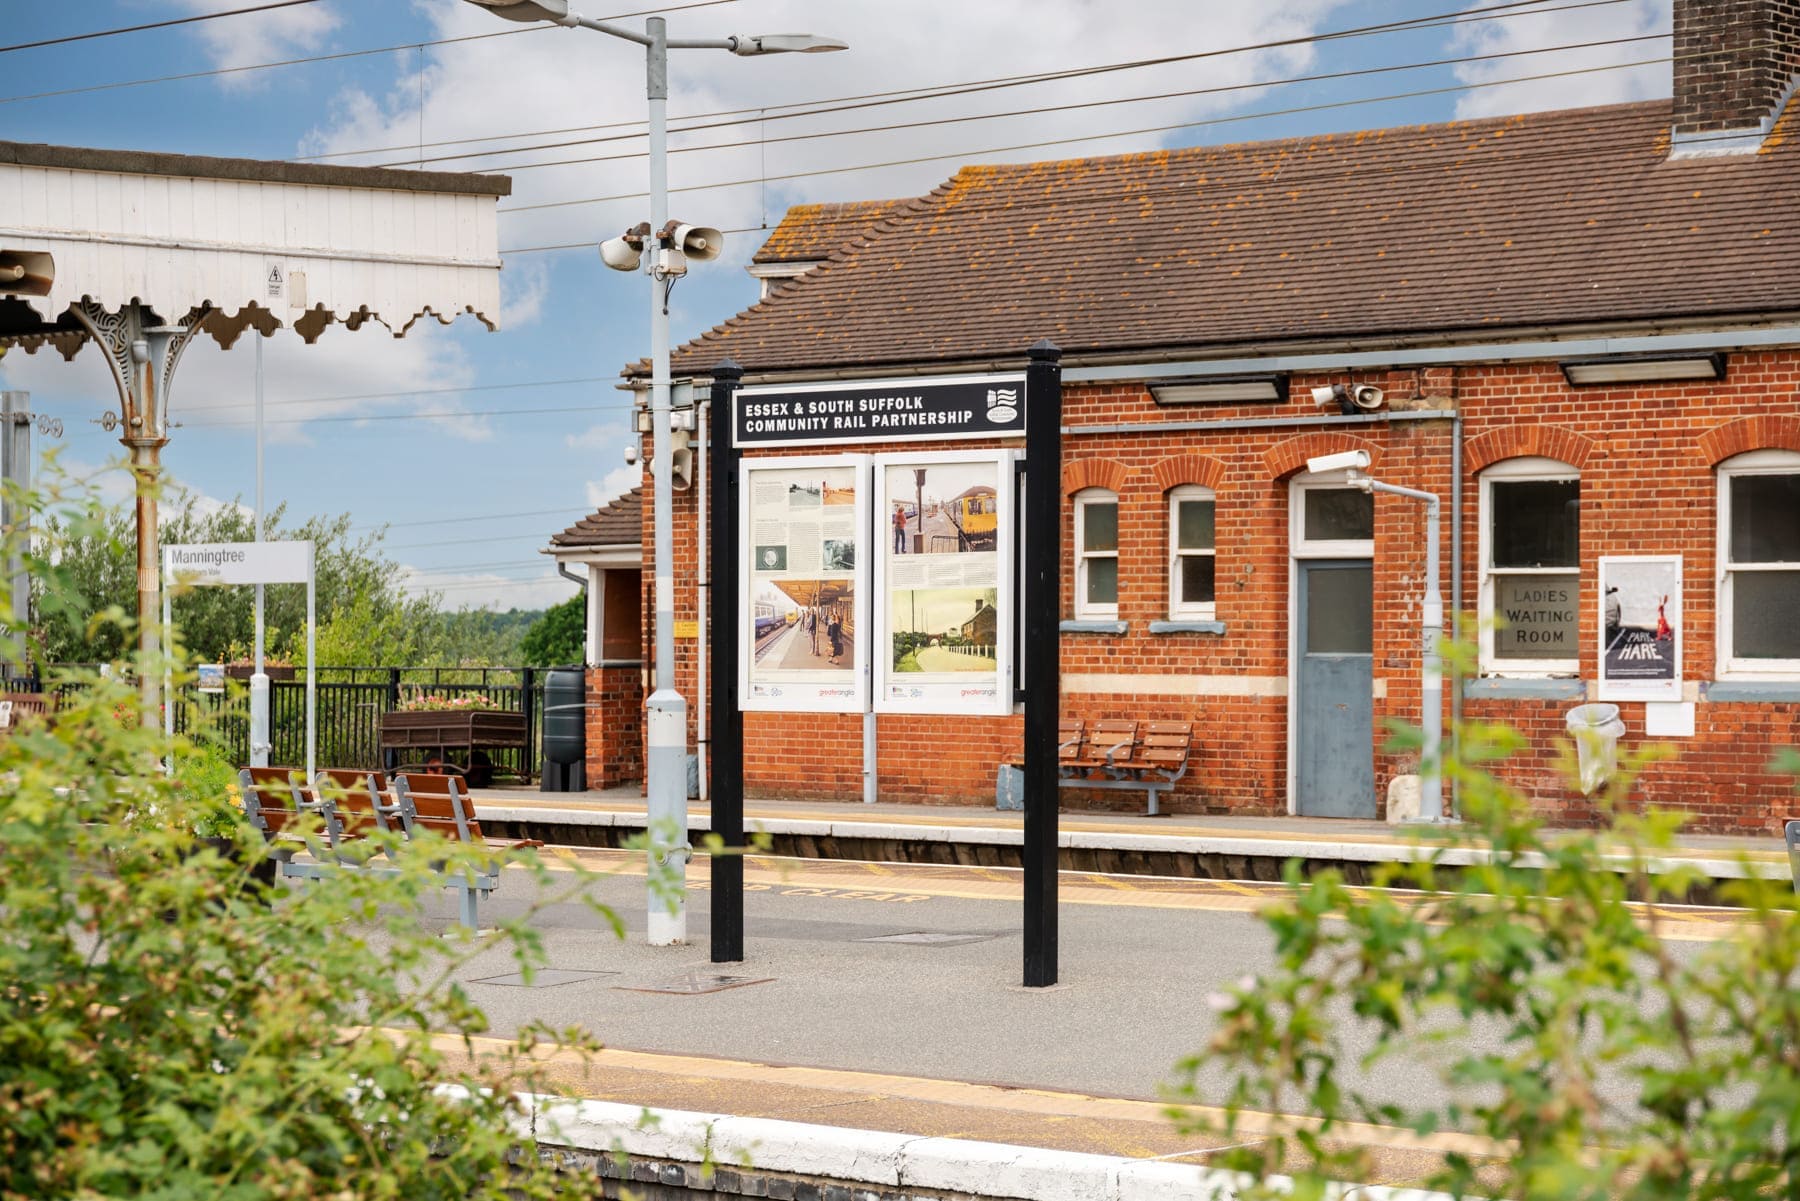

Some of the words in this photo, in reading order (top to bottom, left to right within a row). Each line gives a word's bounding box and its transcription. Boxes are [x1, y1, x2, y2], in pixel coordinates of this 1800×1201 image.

[745, 403, 789, 417] ESSEX
[794, 402, 804, 415] &
[808, 400, 854, 414] SOUTH
[859, 396, 923, 412] SUFFOLK
[745, 417, 829, 433] COMMUNITY
[834, 415, 866, 429] RAIL
[871, 410, 973, 428] PARTNERSHIP
[171, 548, 245, 567] Manningtree
[1513, 589, 1568, 602] LADIES
[1506, 609, 1574, 622] WAITING
[1516, 630, 1564, 643] ROOM
[1617, 643, 1663, 660] HARE
[780, 888, 931, 903] CLEAR
